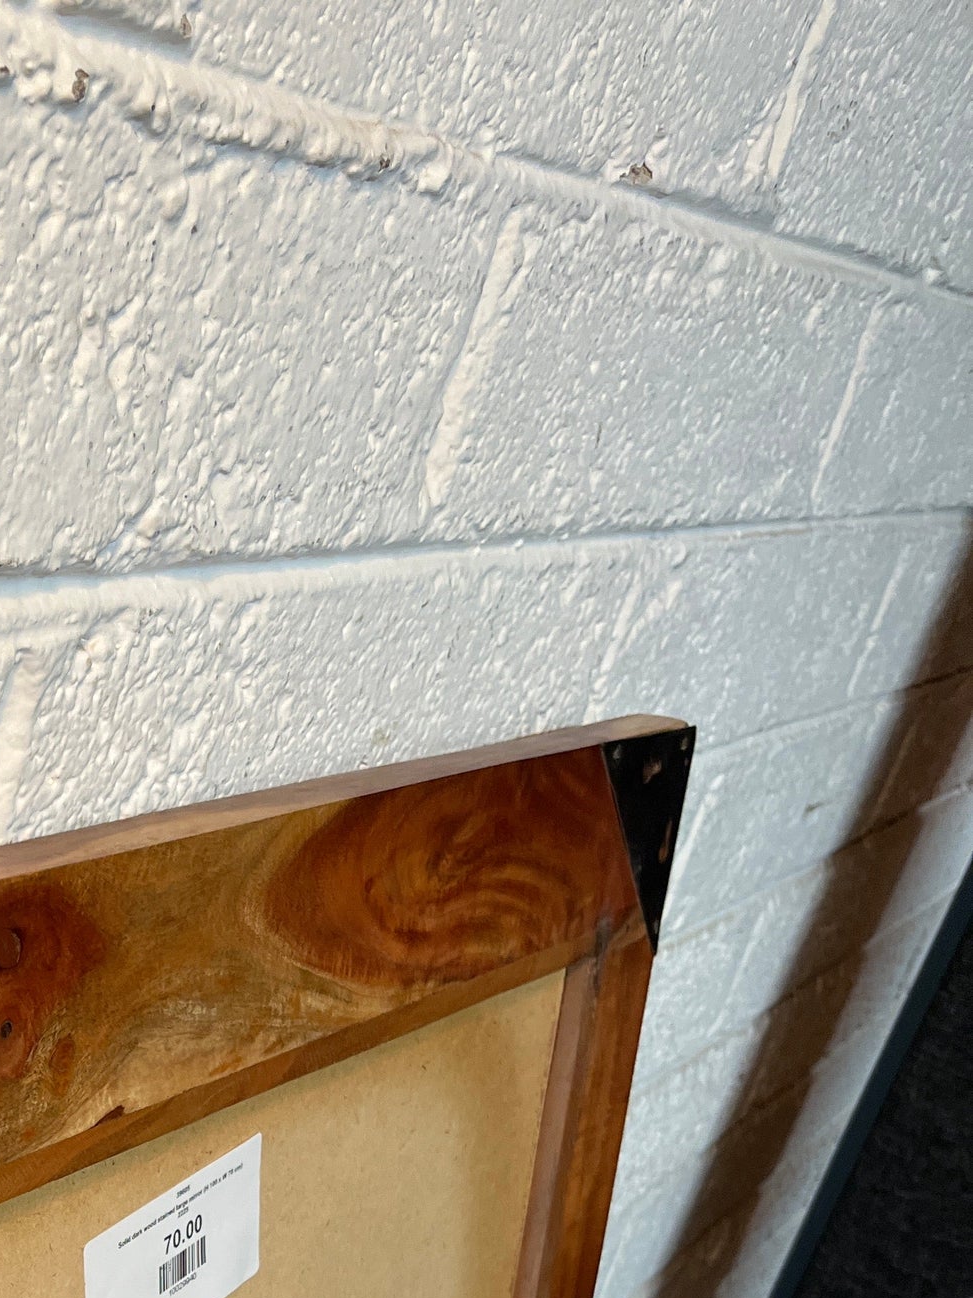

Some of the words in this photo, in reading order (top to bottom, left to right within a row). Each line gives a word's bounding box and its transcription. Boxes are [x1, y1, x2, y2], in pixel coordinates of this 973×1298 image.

[118, 1236, 131, 1249] Solid
[131, 1229, 142, 1240] dark
[144, 1219, 157, 1231] wood
[176, 1200, 188, 1211] large
[163, 1214, 203, 1255] 70.00
